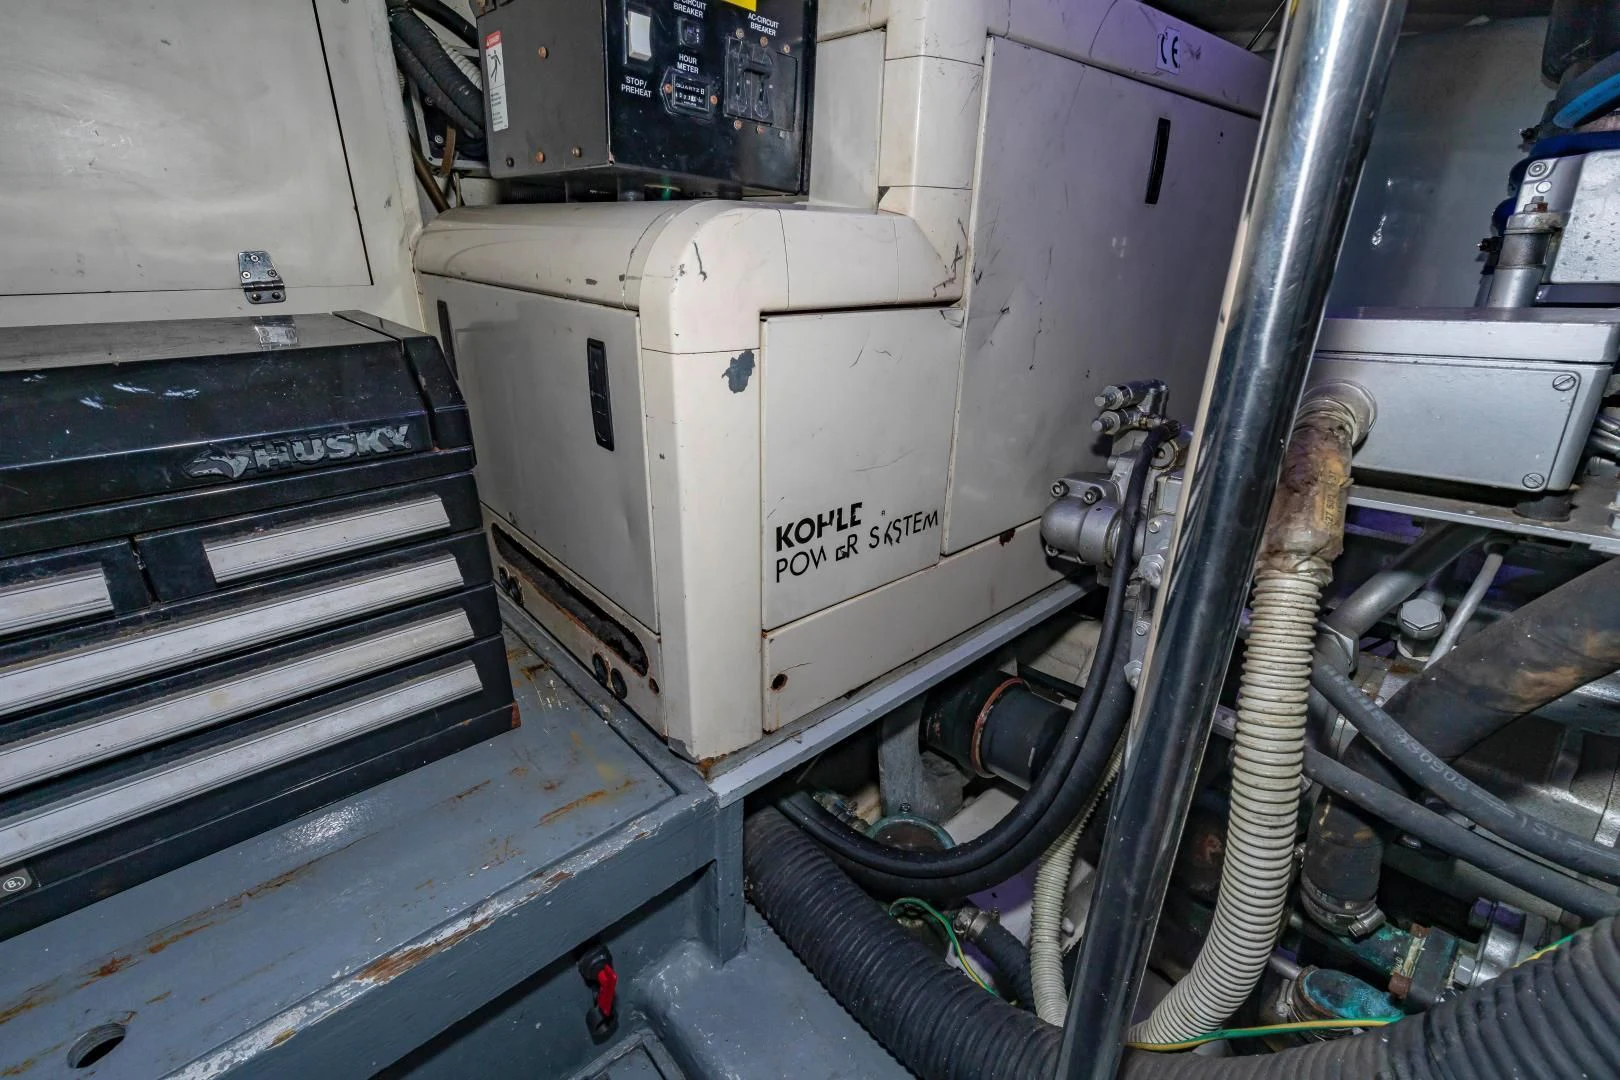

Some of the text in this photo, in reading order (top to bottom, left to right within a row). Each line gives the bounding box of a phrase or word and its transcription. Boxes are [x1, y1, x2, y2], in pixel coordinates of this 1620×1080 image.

[673, 2, 703, 19] BREAKER
[748, 12, 780, 29] AC-CIRCUIT
[750, 21, 776, 37] BREAKER
[678, 53, 698, 66] HOUR
[676, 61, 699, 75] METER
[625, 76, 648, 88] STOP/
[621, 84, 652, 98] PREHEAT
[251, 423, 410, 472] HUSKY
